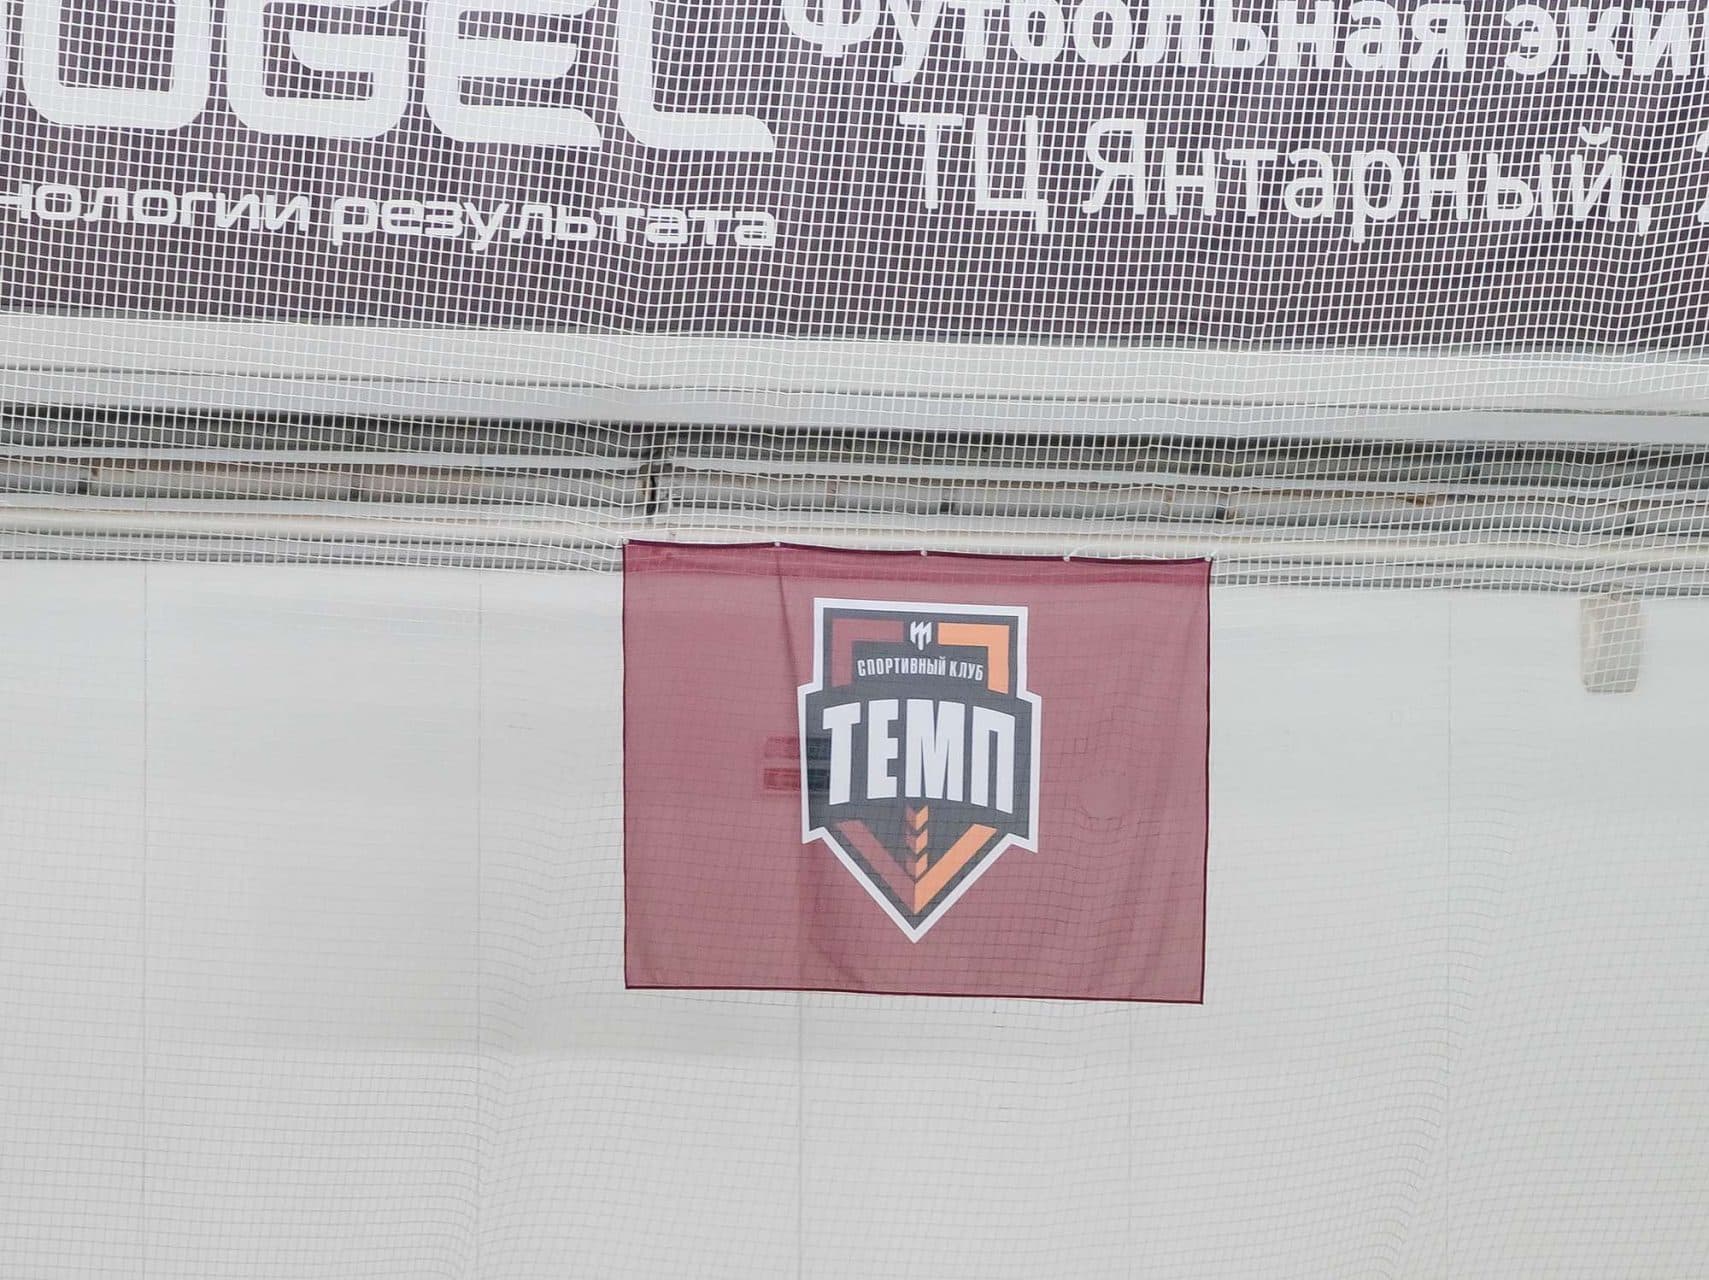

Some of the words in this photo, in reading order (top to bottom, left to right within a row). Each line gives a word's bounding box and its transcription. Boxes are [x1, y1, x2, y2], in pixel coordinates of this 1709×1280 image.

[0, 0, 775, 153] OGEL
[1504, 4, 1709, 76] эки
[899, 113, 1049, 233] ТЦ
[1082, 118, 1652, 242] Янтарный,
[332, 199, 777, 250] результата
[857, 656, 946, 677] СПОРТИВНЫЙ
[949, 661, 984, 681] КЛУБ
[822, 699, 1016, 814] ТЕМП
